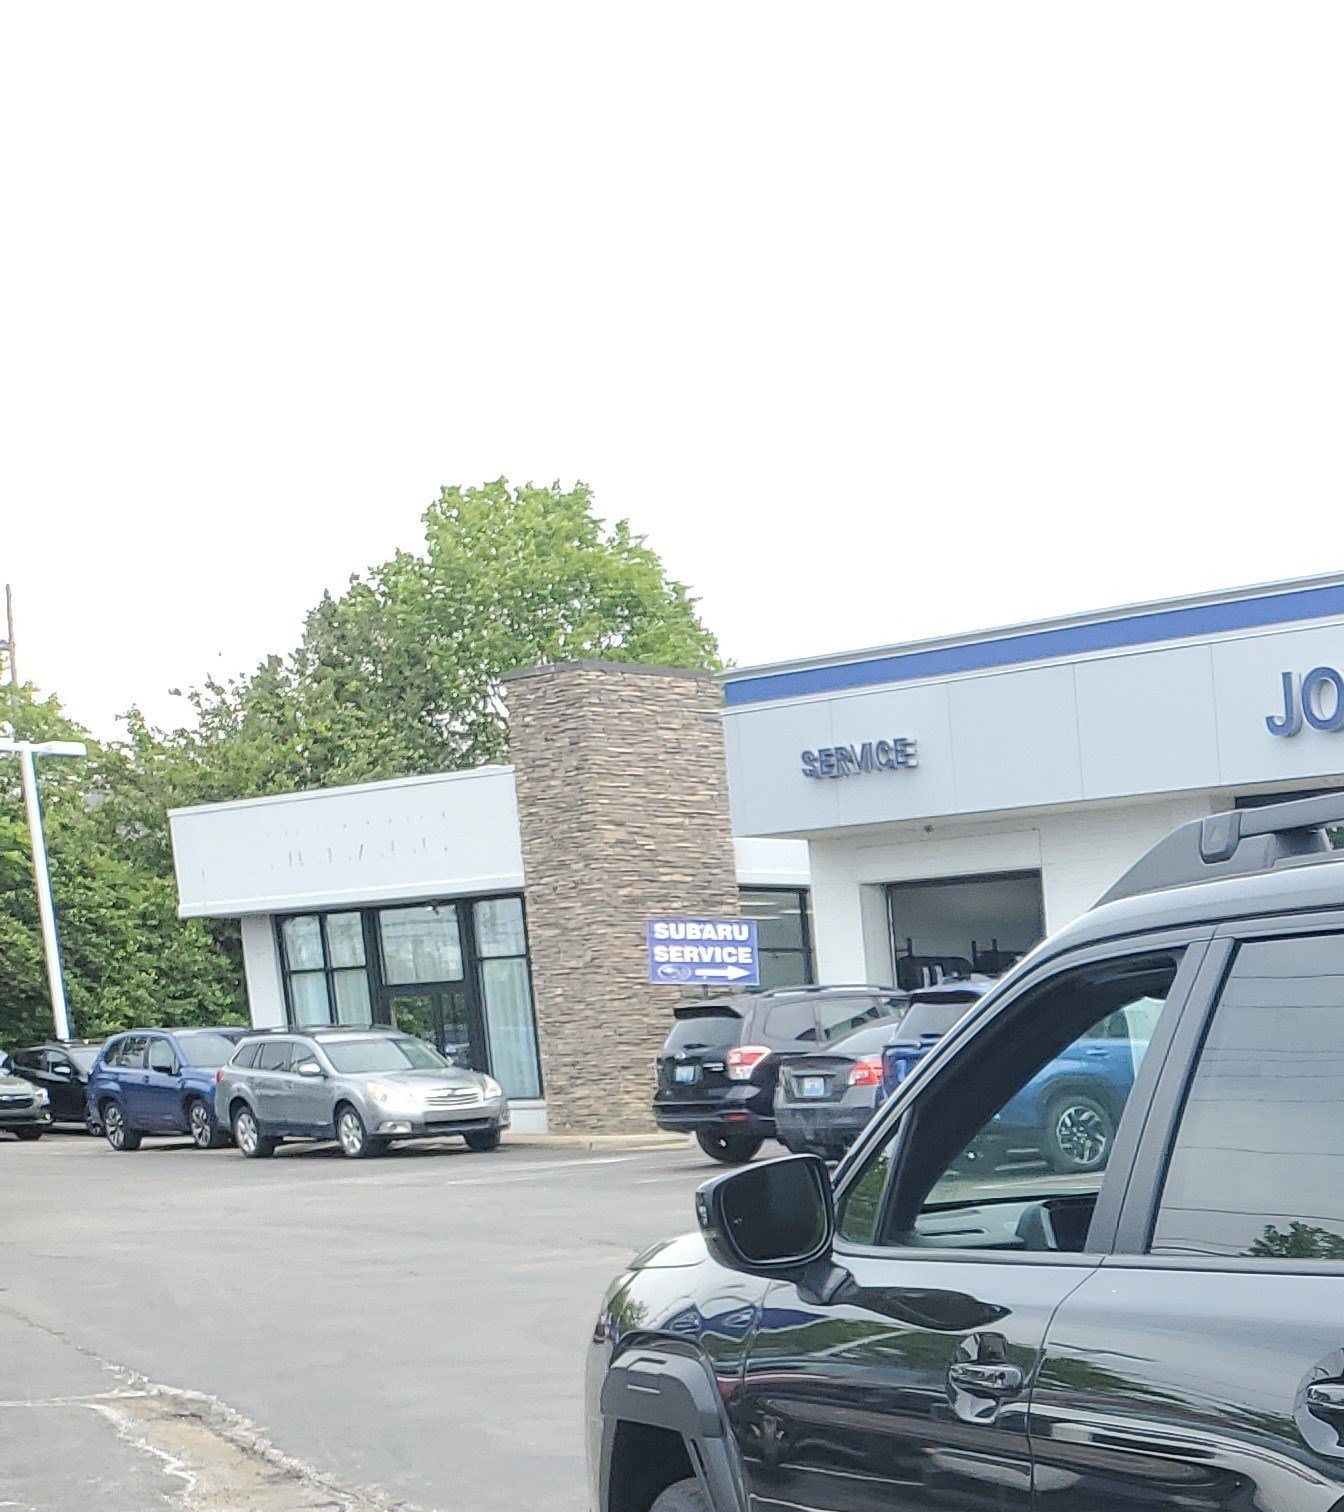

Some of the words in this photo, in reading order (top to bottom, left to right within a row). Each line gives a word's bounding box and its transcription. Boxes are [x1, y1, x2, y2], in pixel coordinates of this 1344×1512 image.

[801, 738, 919, 779] SERVICE
[653, 922, 750, 941] SUBARU
[653, 945, 754, 964] SERVICE
